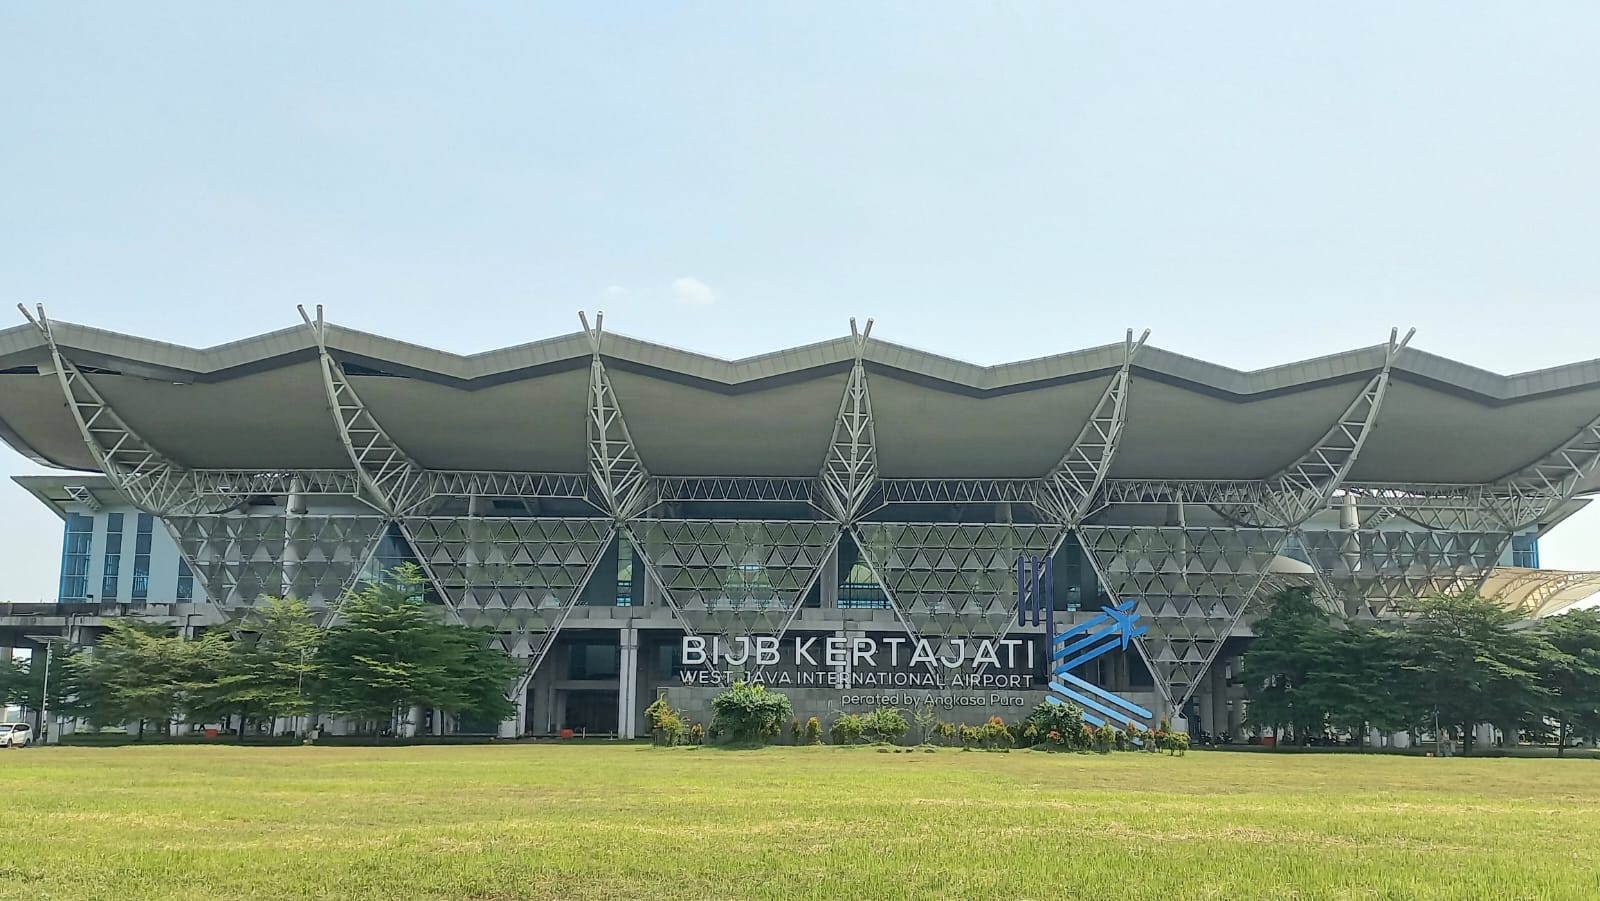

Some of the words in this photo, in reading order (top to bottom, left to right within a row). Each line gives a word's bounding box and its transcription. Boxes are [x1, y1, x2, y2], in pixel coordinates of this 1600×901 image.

[681, 636, 781, 665] BIJB
[795, 637, 1035, 669] KERTAJATI
[679, 670, 734, 684] WEST
[742, 670, 791, 685] JAVA
[797, 671, 945, 687] INTERNATIONAL
[951, 673, 1034, 688] AIRPORT
[903, 694, 921, 708] by
[923, 694, 986, 710] Angkasa
[990, 694, 1025, 706] Pura
